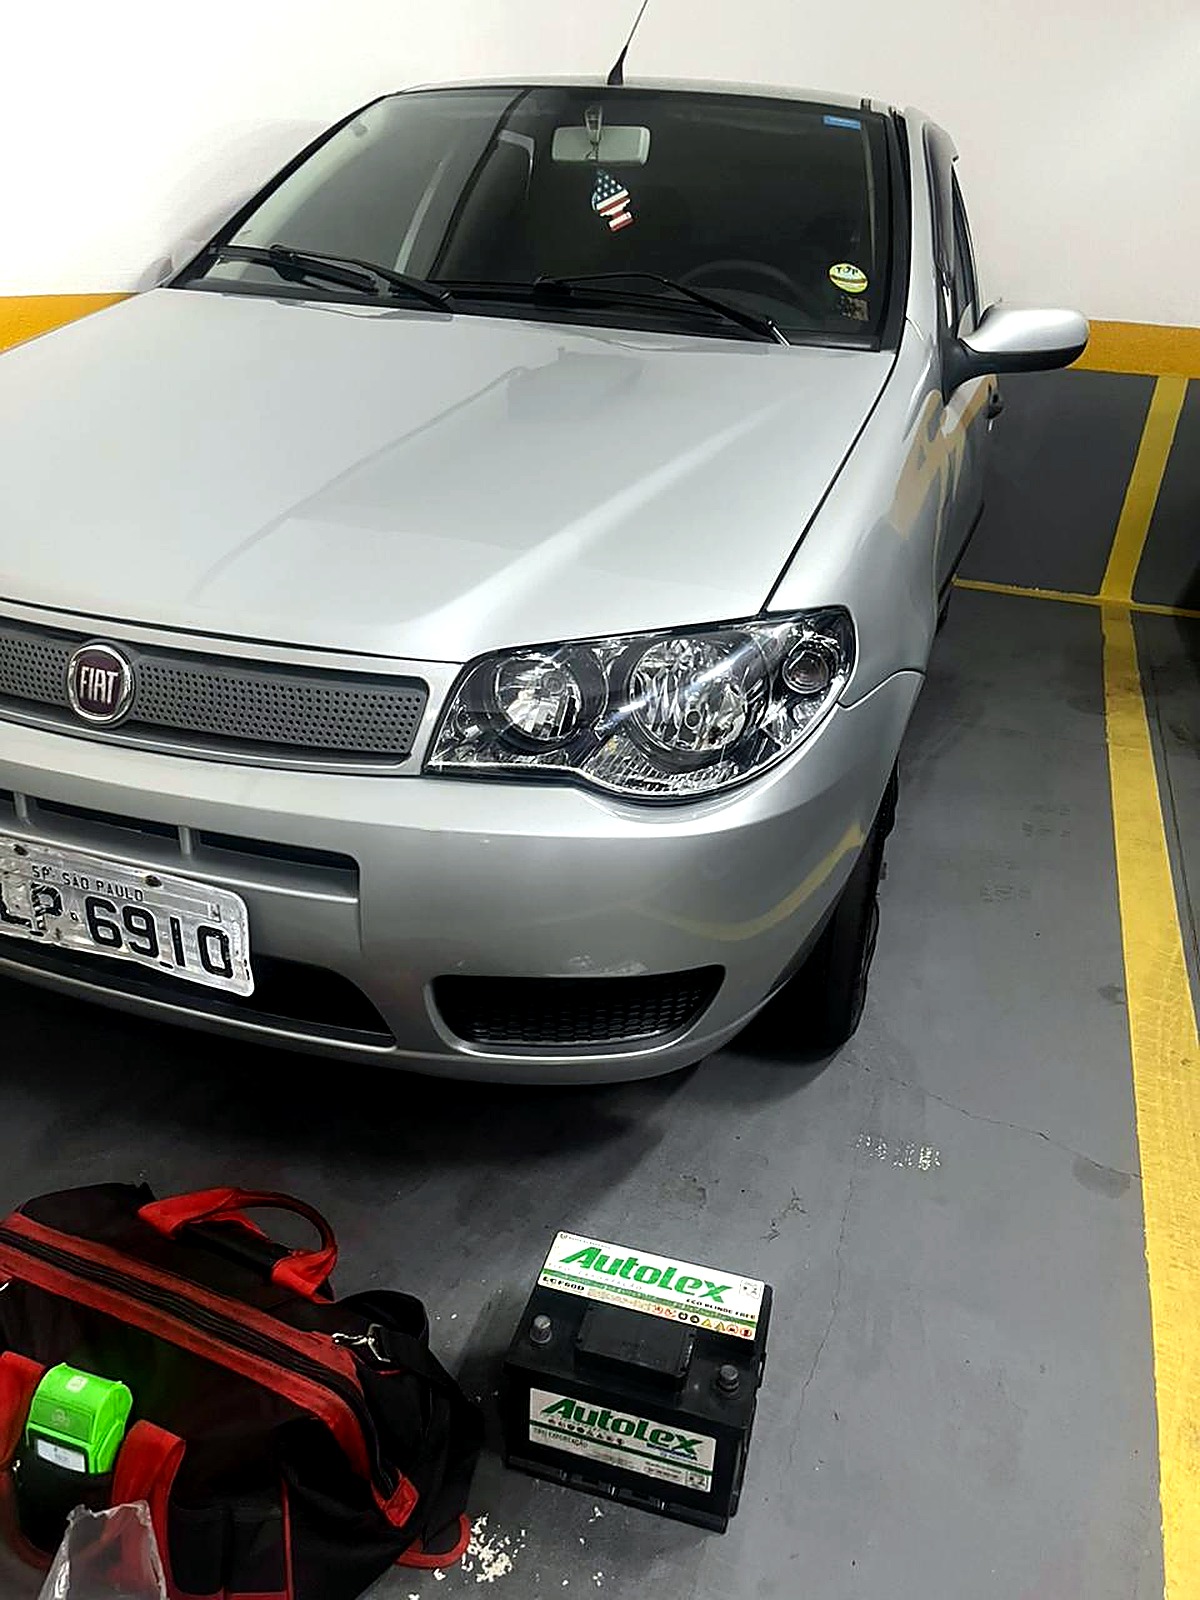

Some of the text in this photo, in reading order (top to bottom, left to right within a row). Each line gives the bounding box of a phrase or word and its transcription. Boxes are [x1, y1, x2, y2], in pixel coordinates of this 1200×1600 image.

[80, 666, 119, 704] FIAT
[96, 880, 144, 901] PAULO
[85, 896, 234, 978] 6910
[558, 1246, 734, 1305] Autolex
[541, 1398, 703, 1456] Autolex
